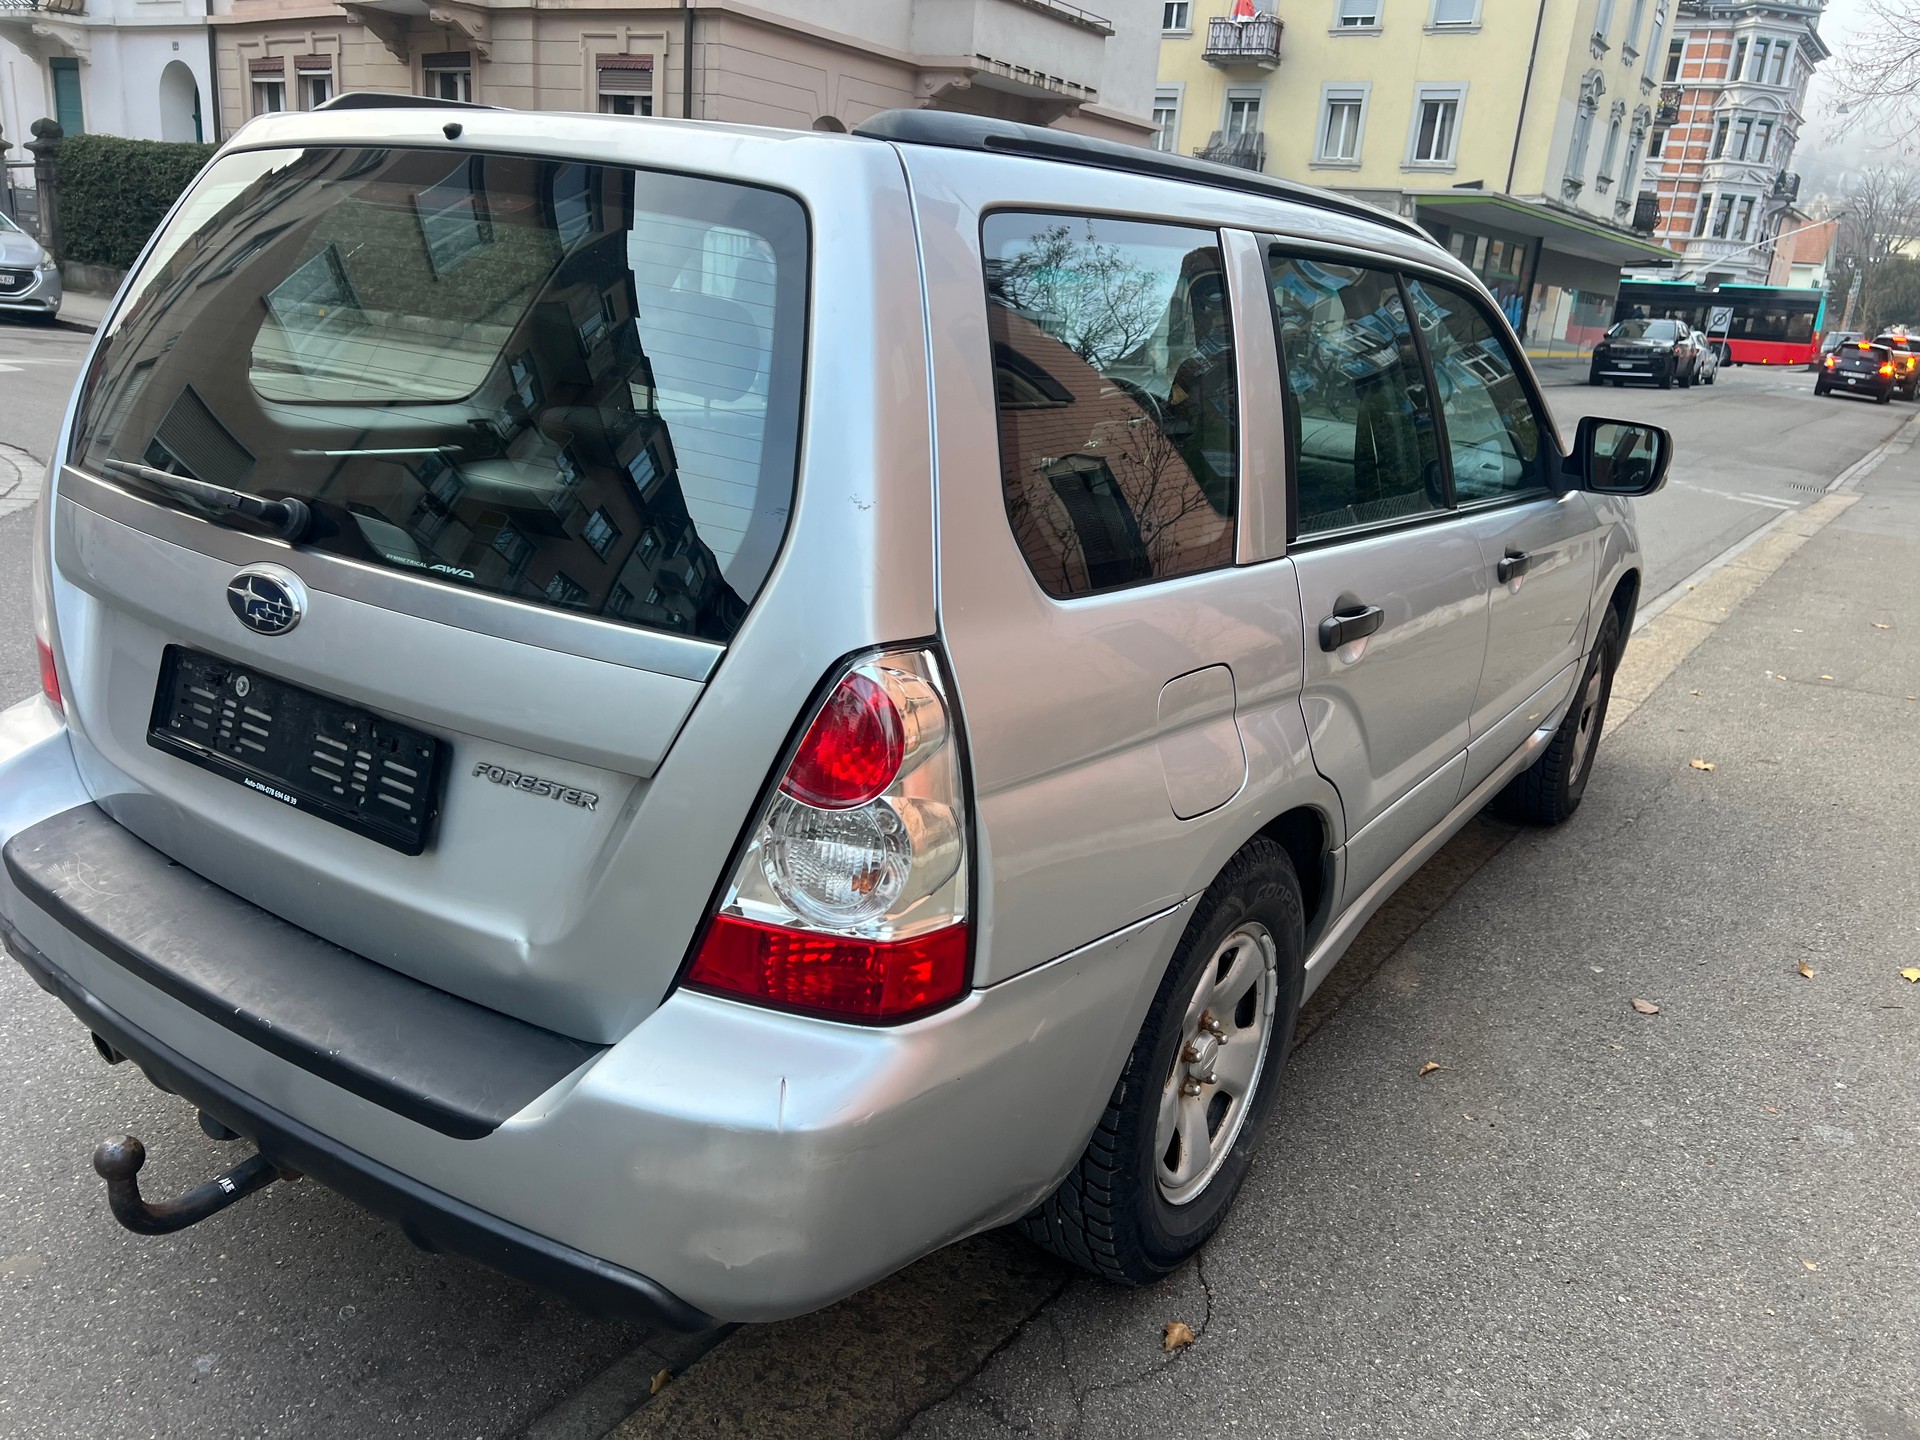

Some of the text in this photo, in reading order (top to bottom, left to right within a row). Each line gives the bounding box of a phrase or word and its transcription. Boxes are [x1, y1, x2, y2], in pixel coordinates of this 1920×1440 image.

[386, 553, 475, 579] SYMMETRICAL AWD
[290, 796, 298, 805] 39
[472, 762, 599, 811] FORESTER
[1254, 882, 1302, 928] COOPER
